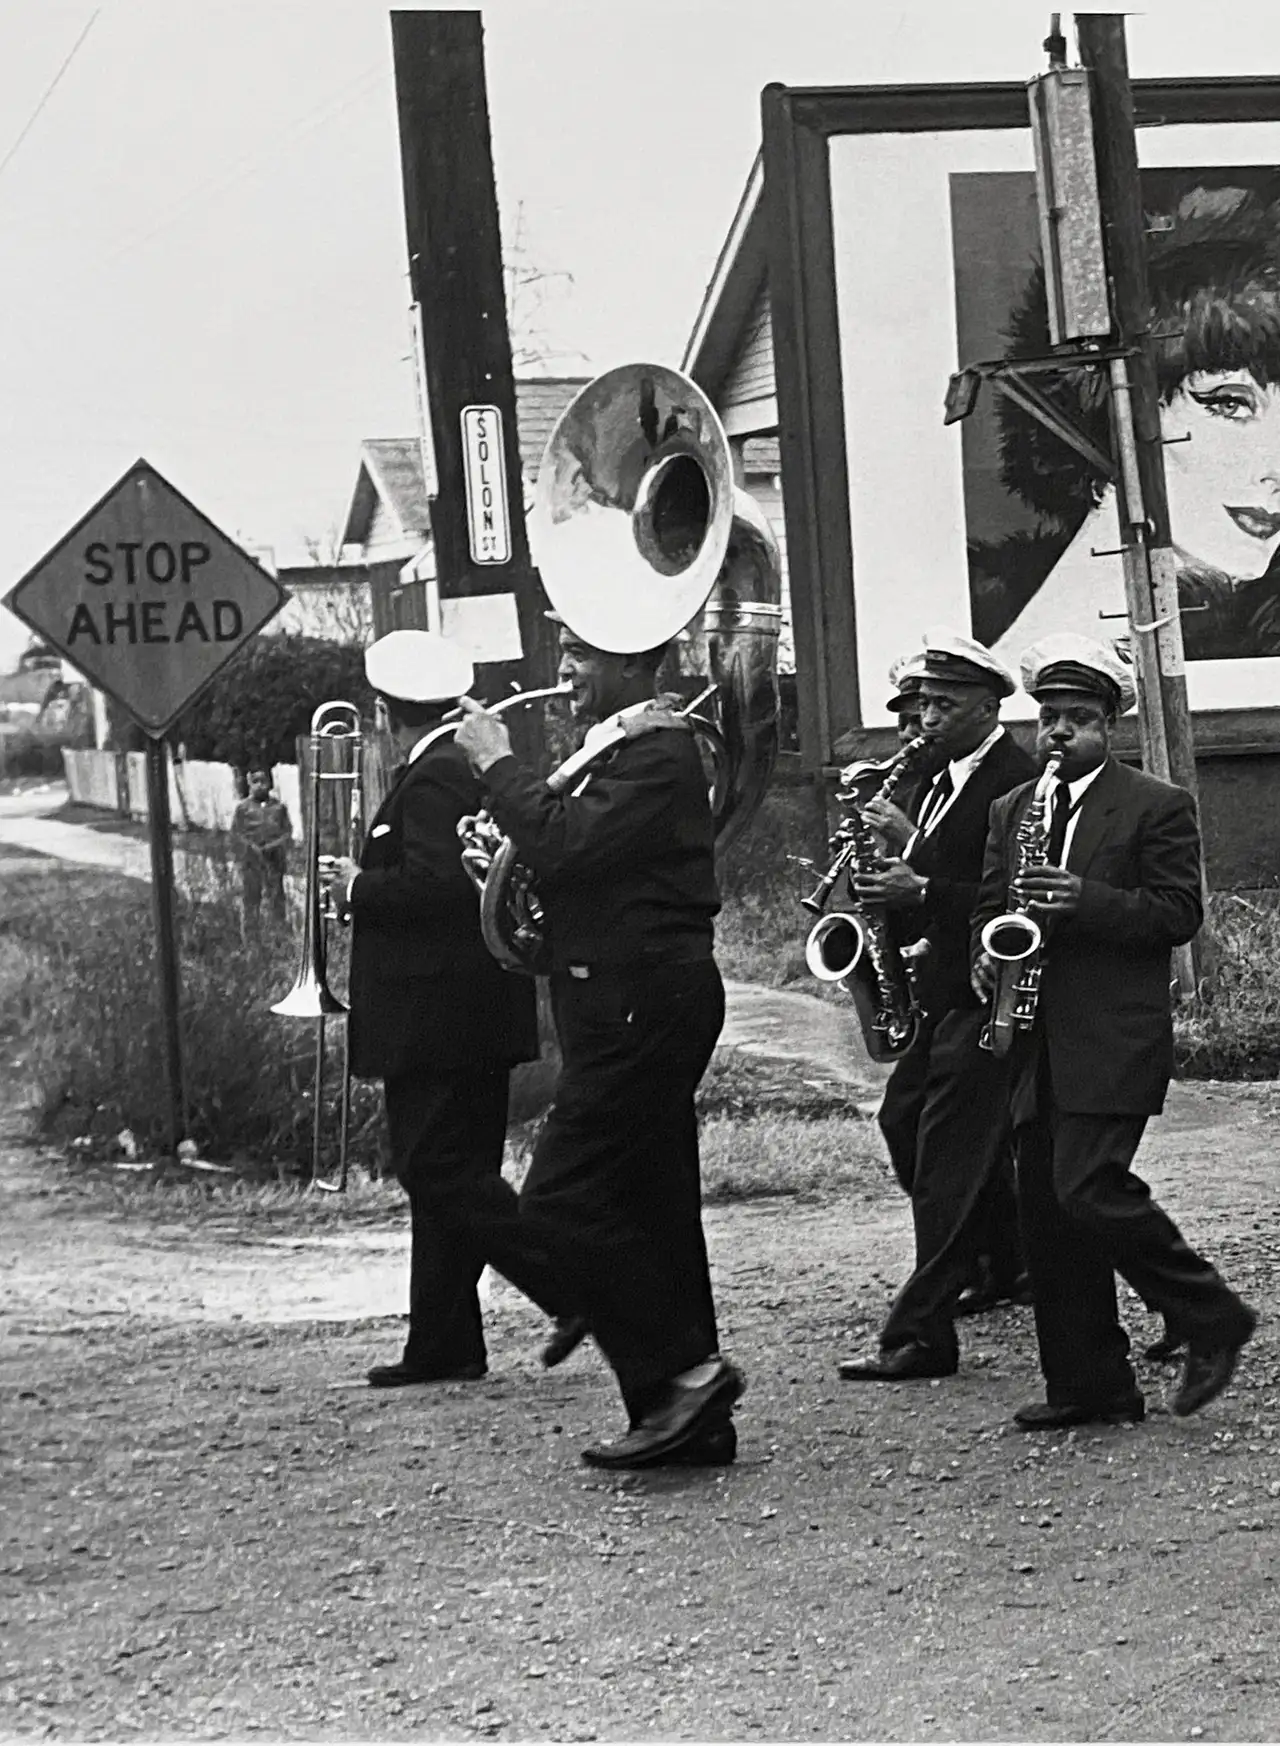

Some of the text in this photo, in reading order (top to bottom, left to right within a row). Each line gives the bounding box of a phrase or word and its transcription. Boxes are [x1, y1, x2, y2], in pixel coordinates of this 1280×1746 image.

[477, 416, 493, 531] SOLON
[84, 542, 211, 586] STOP
[67, 600, 243, 646] AHEAD
